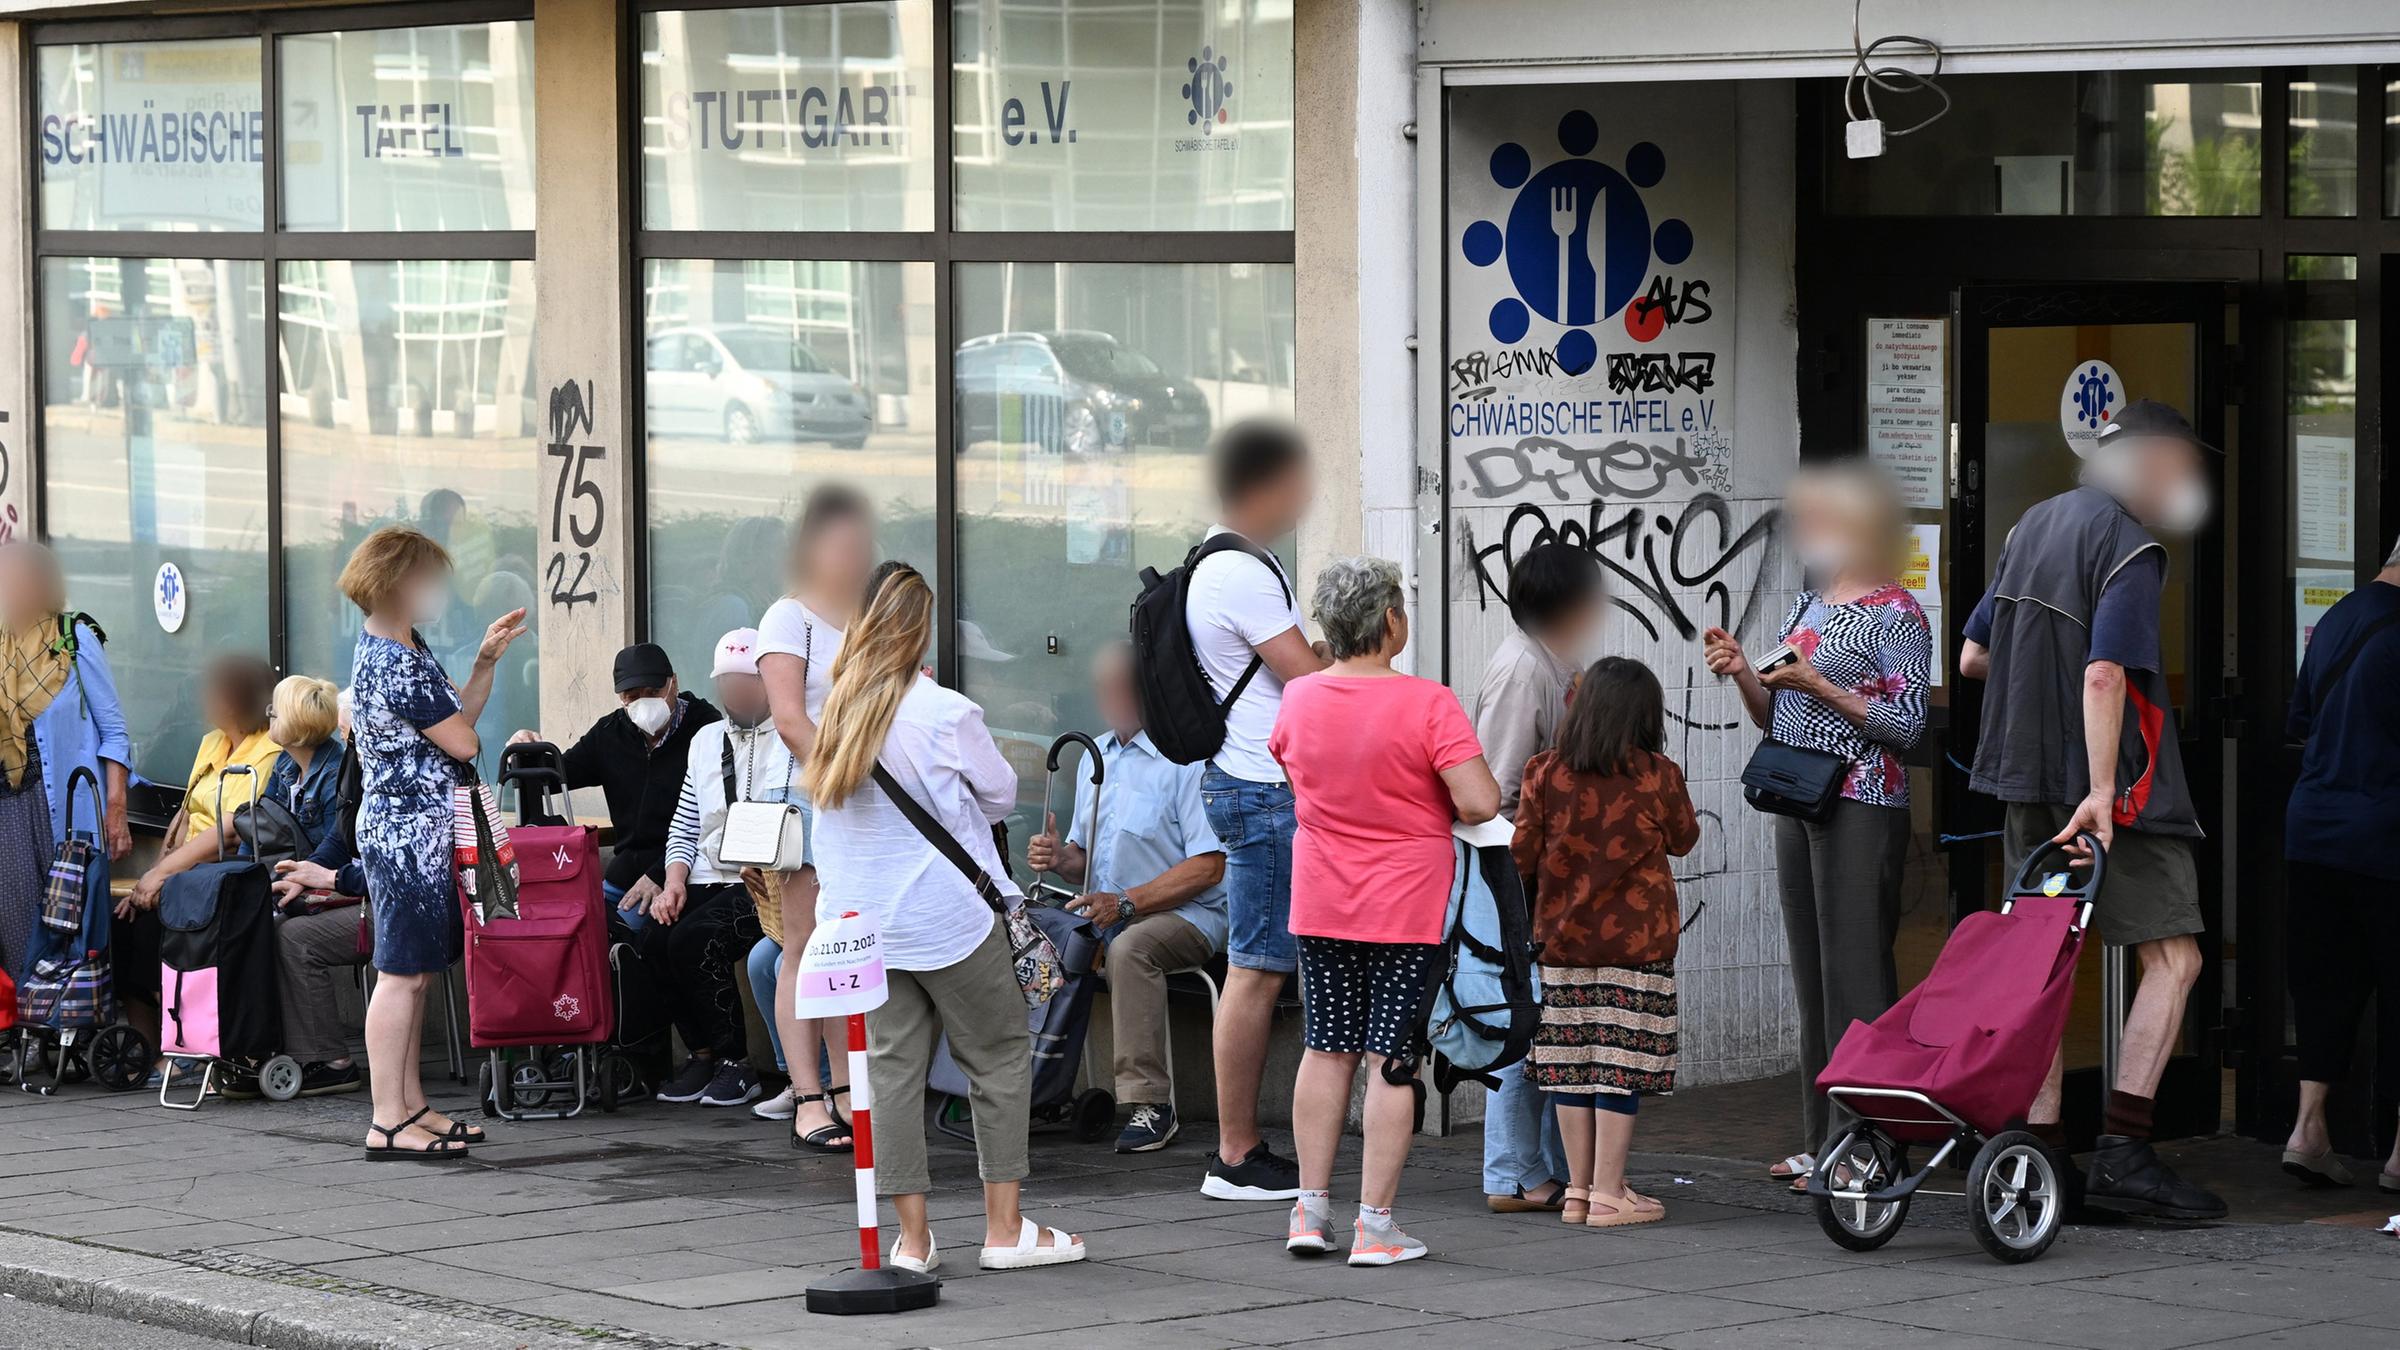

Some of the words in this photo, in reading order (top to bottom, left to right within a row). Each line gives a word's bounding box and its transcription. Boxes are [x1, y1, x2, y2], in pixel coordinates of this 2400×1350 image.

[42, 100, 263, 164] SCHWÄBISCHE
[357, 104, 463, 158] TAFEL
[668, 86, 916, 150] STUTTGART
[1002, 81, 1076, 146] e.V.
[1886, 387, 1900, 395] para
[1608, 400, 1674, 433] TAFEL
[1682, 399, 1716, 431] e.V.
[548, 443, 606, 548] 75
[828, 977, 837, 991] L
[849, 974, 860, 989] Z
